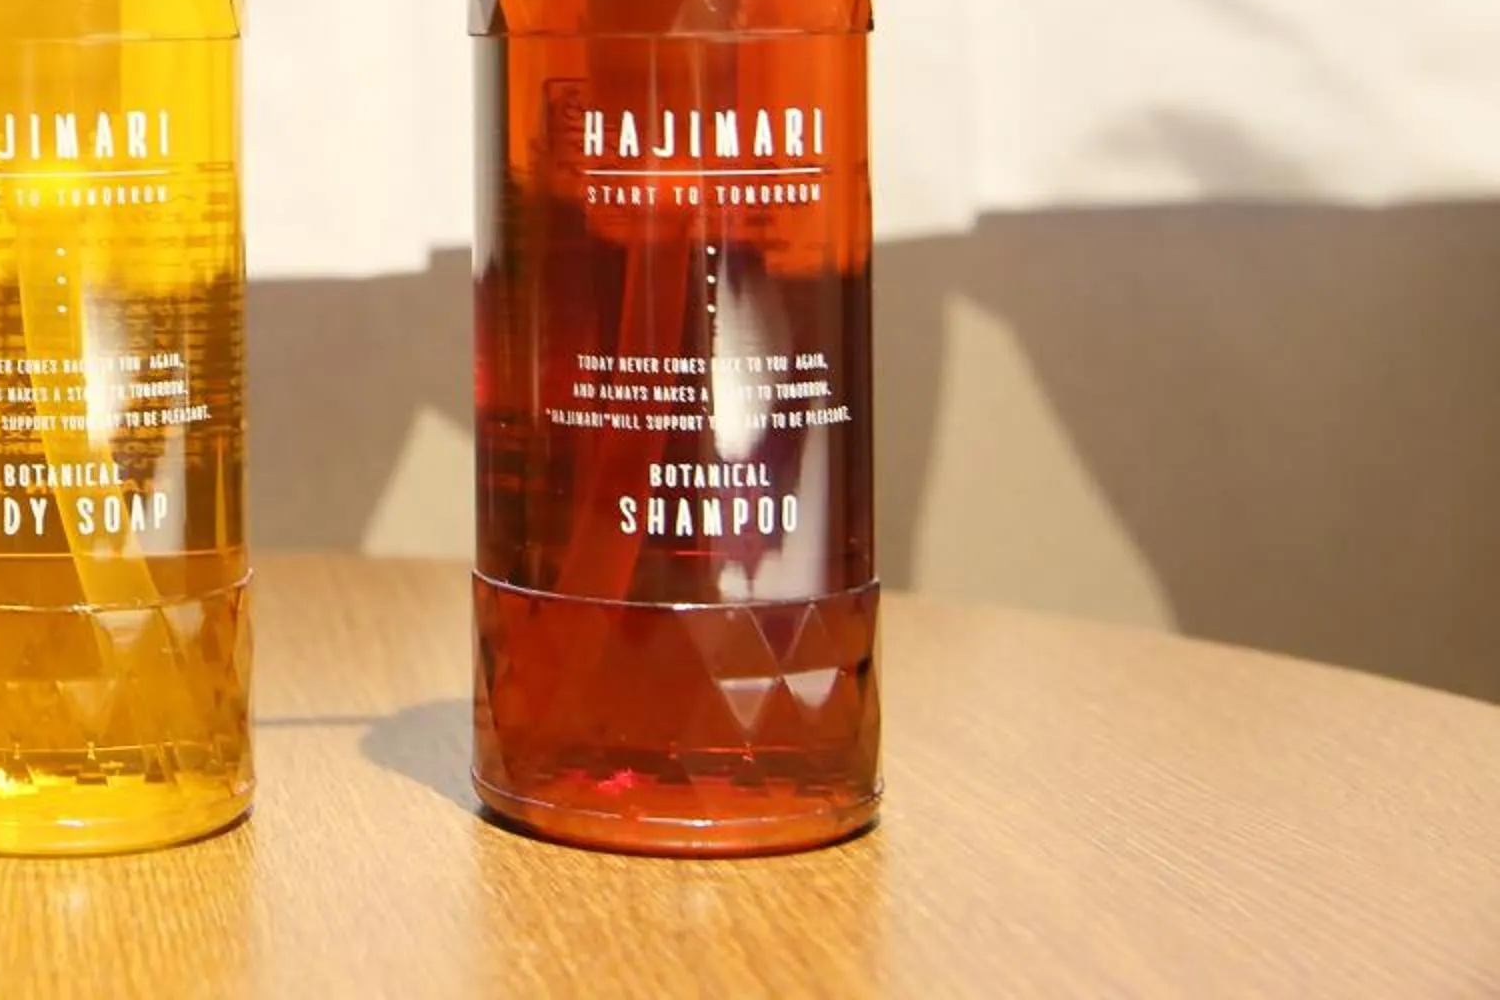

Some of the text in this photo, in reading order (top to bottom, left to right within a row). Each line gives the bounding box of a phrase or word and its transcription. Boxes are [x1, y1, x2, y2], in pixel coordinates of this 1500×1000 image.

[583, 107, 824, 158] HAJIMARI
[587, 183, 822, 206] START TO TOMORROW
[17, 358, 58, 375] COMES
[119, 356, 141, 371] YOU
[577, 354, 614, 372] TODAY
[618, 356, 659, 374] NEVER
[663, 357, 706, 375] COMES
[746, 356, 761, 373] TO
[766, 354, 788, 372] YOU
[7, 386, 48, 403] MAKES
[53, 386, 61, 403] A
[573, 382, 595, 399] AND
[600, 384, 648, 401] ALWAYS
[653, 385, 696, 403] MAKES
[701, 386, 709, 403] A
[757, 383, 772, 400] TO
[2, 415, 56, 431] SUPPORT
[126, 411, 140, 428] TO
[143, 410, 158, 428] BE
[645, 414, 703, 432] SUPPORT
[771, 412, 786, 430] TO
[789, 411, 803, 428] BE
[4, 462, 124, 488] BOTANICAL
[650, 462, 771, 488] BOTANICAL
[76, 491, 169, 537] SOAP
[619, 493, 799, 537] SHAMPOO
